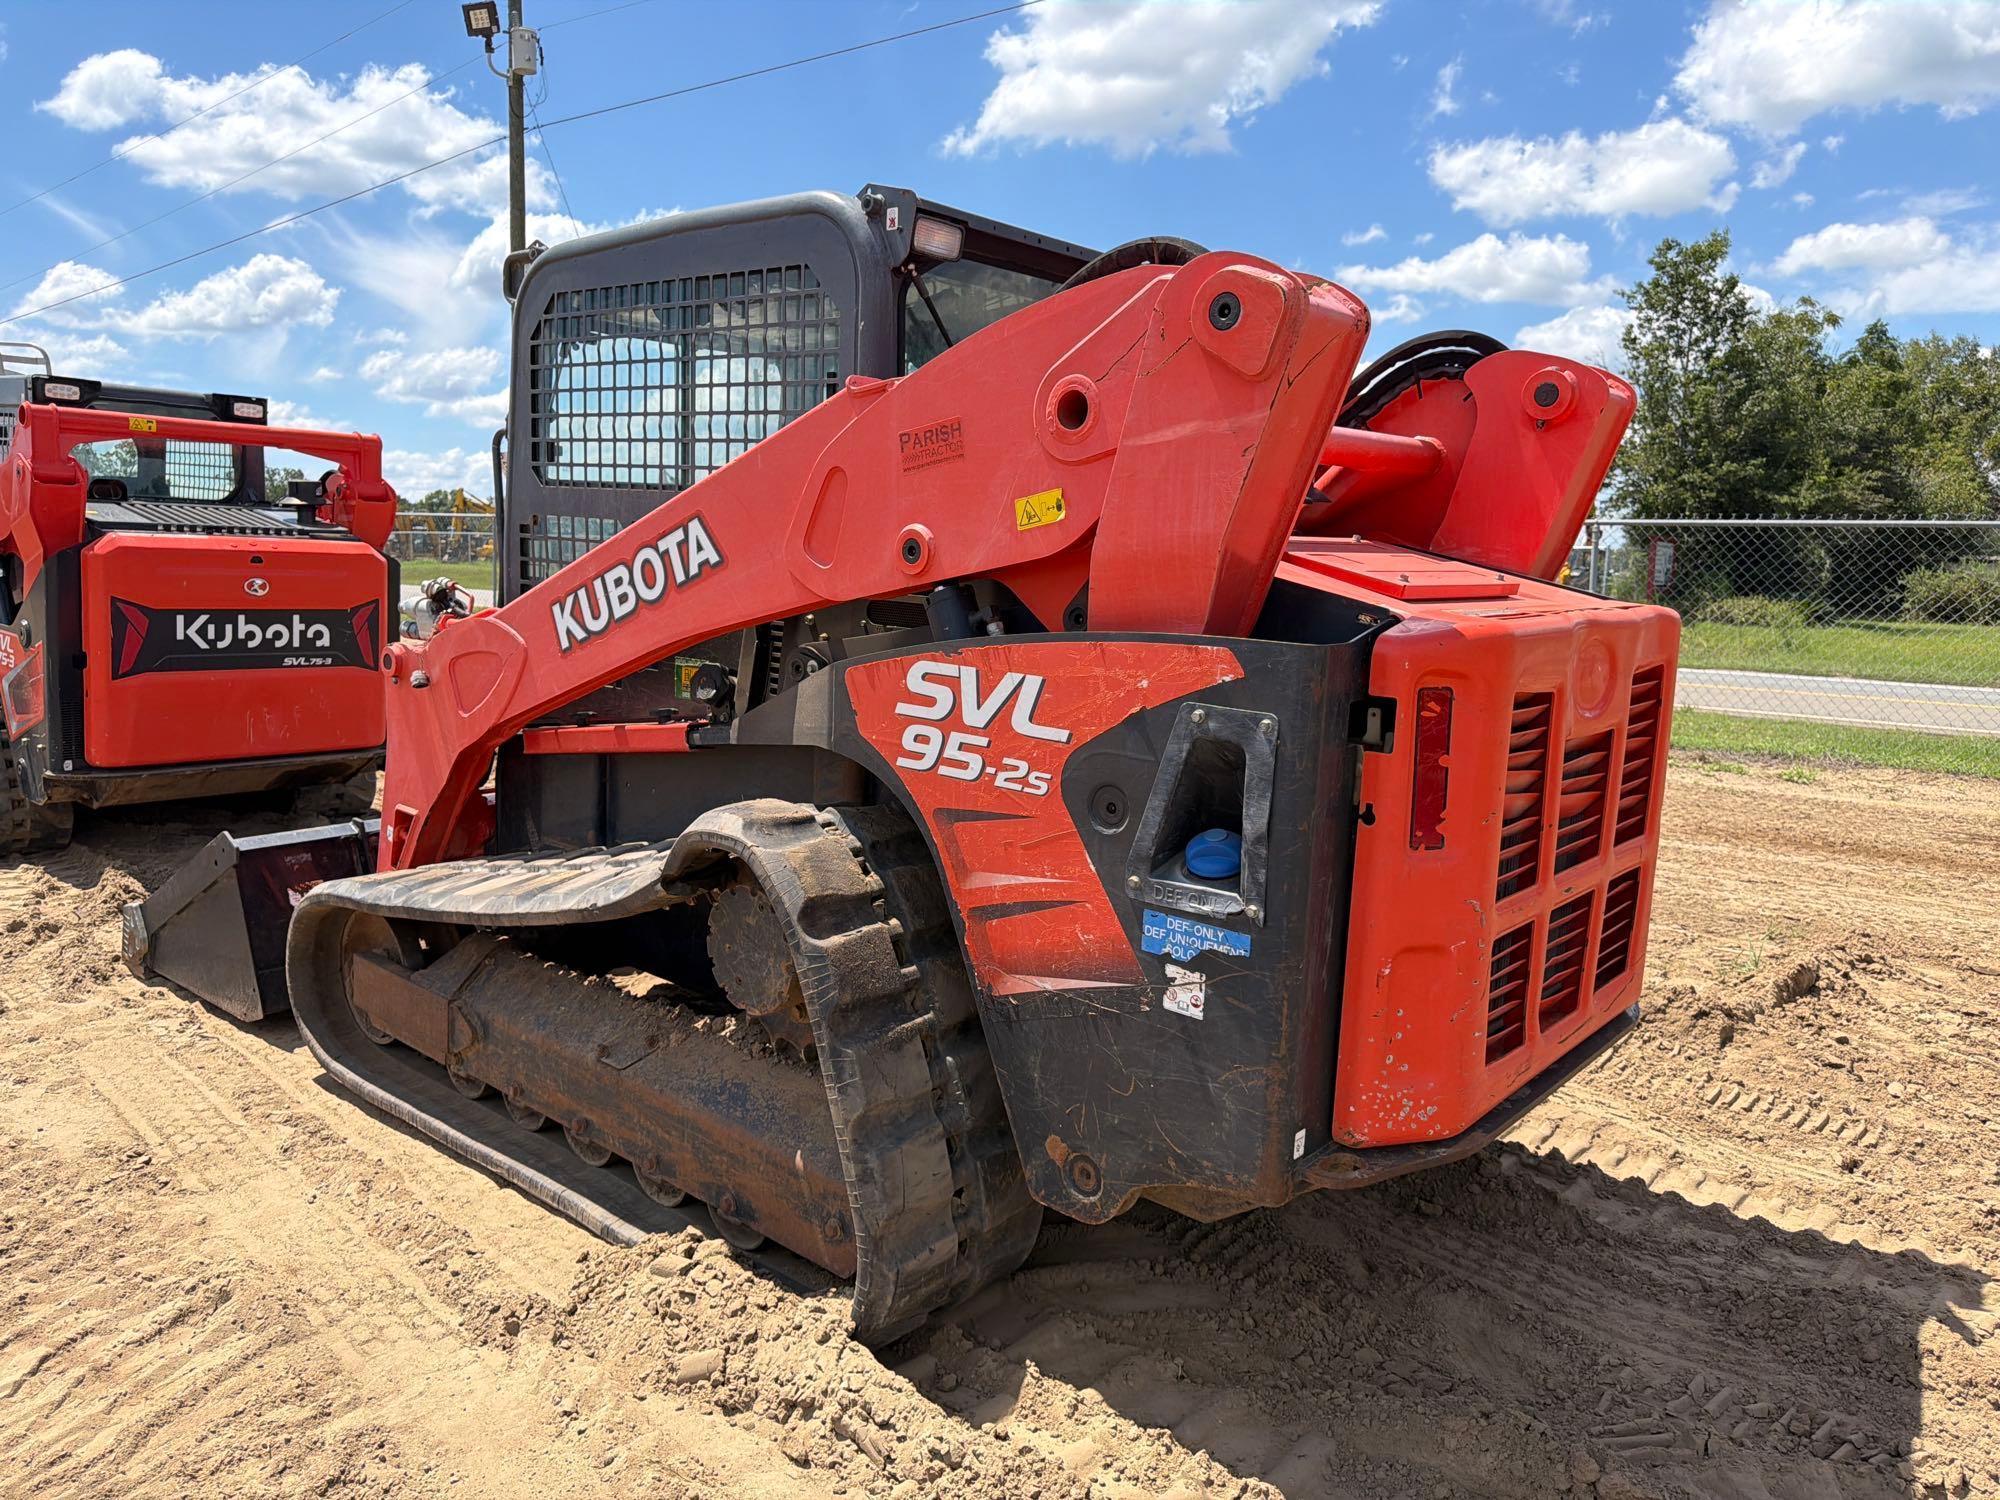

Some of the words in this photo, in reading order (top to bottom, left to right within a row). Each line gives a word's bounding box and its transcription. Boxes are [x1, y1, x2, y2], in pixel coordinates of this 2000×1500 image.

[899, 421, 962, 453] PARISH
[551, 517, 722, 651] KUBOTA
[176, 614, 330, 649] Kubota
[895, 660, 1073, 744] SVL
[1153, 884, 1182, 906] DEF
[1144, 924, 1166, 940] DEF
[1167, 917, 1190, 933] DEF
[1193, 925, 1225, 943] ONLY
